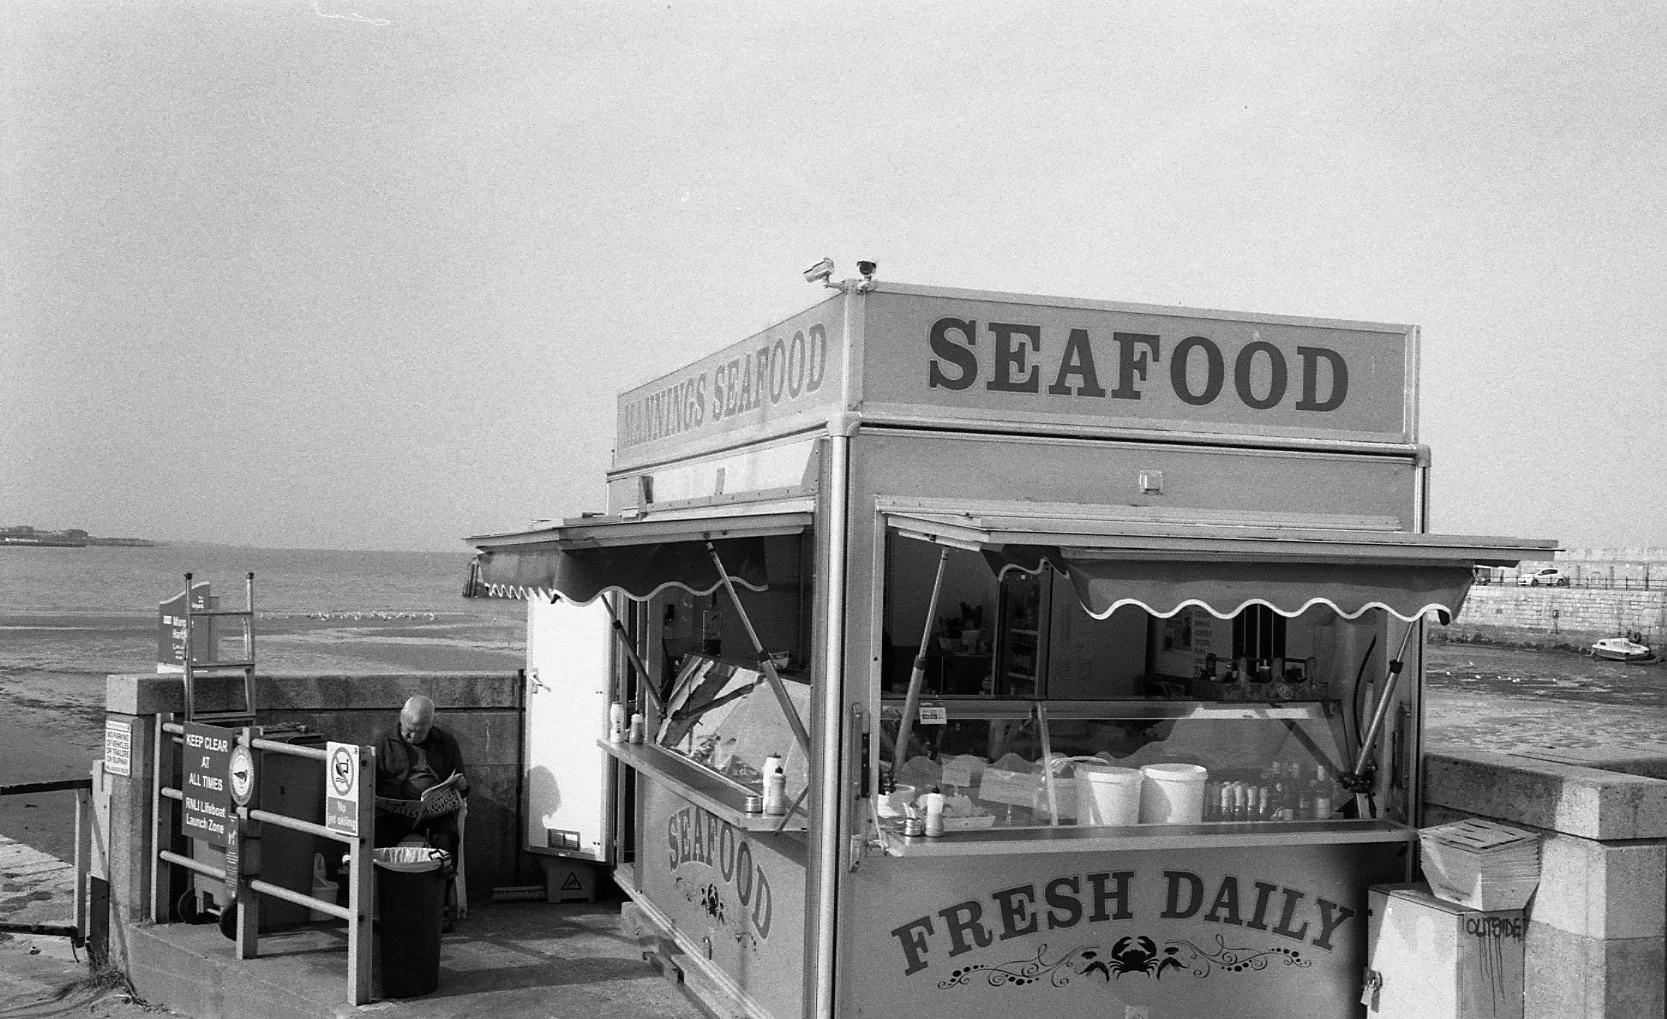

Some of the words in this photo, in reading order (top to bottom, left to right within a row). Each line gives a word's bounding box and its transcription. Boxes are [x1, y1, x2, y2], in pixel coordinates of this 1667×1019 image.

[928, 316, 1350, 412] SEAFOOD
[622, 373, 708, 447] MANNINGS
[712, 322, 828, 422] SEAFOOD
[186, 733, 204, 748] KEEP
[204, 737, 228, 753] CLEAR
[201, 755, 210, 769] AT
[189, 772, 202, 787] ALL
[202, 775, 223, 792] TIMES
[186, 797, 200, 812] RNLI
[200, 801, 226, 819] Lifeboat
[337, 801, 347, 813] No
[186, 812, 208, 829] Launch
[208, 819, 225, 835] Zone
[667, 806, 772, 940] SEAFOOD
[891, 870, 1136, 976] FRESH
[1160, 869, 1357, 951] DAILY
[1466, 916, 1522, 940] OUTSIDE
